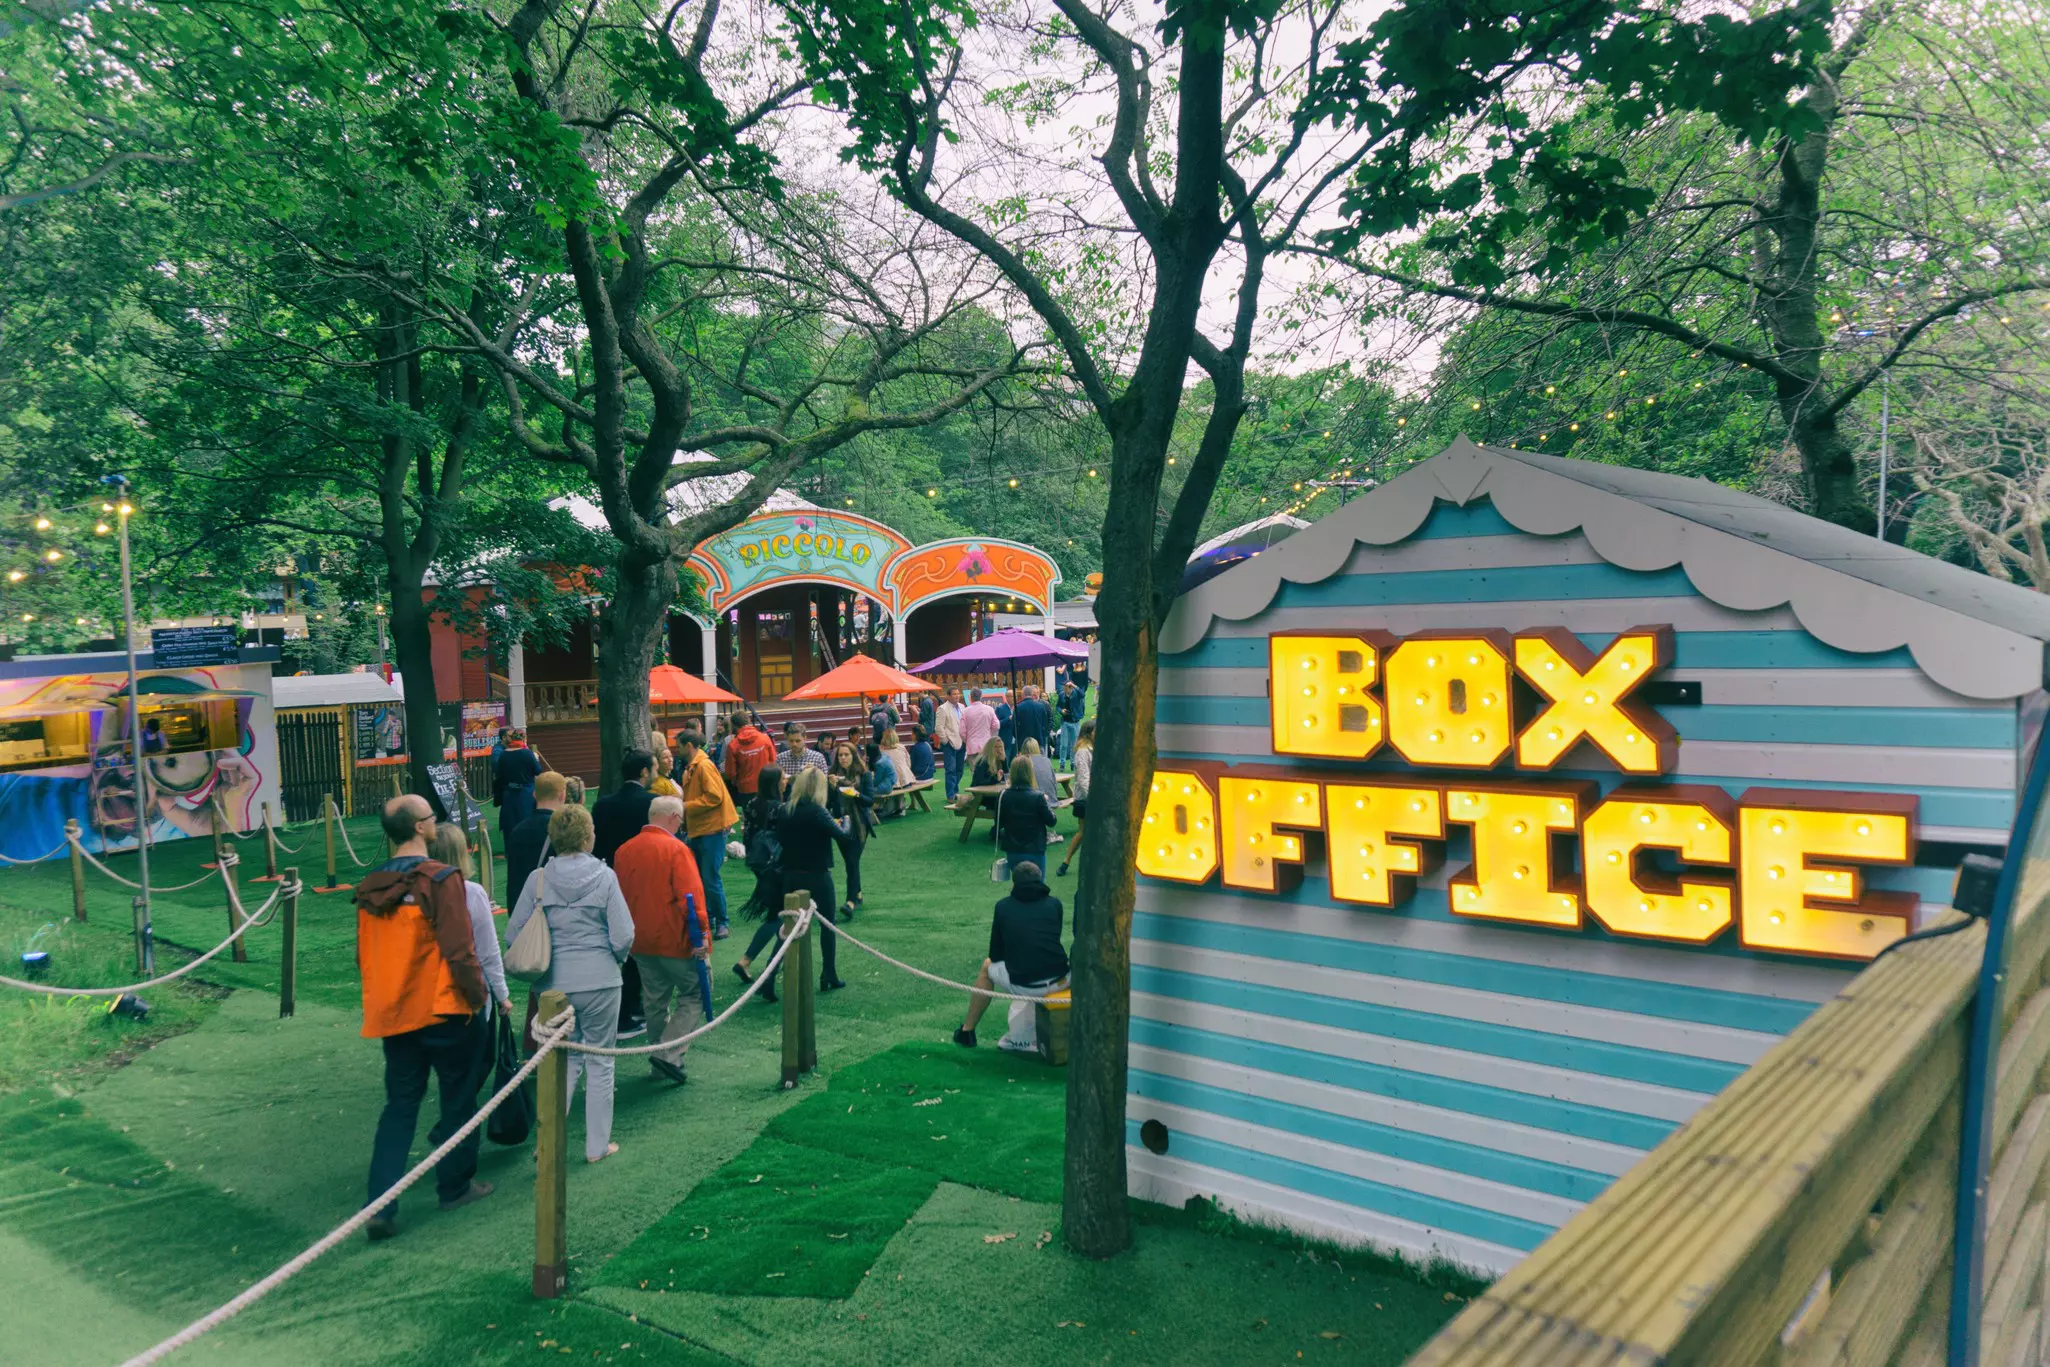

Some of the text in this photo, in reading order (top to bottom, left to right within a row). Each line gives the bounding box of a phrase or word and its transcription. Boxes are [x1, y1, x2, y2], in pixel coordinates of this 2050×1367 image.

[738, 532, 872, 569] PICCOLO
[1269, 625, 1676, 776] BOX
[1136, 760, 1920, 963] OFFICE
